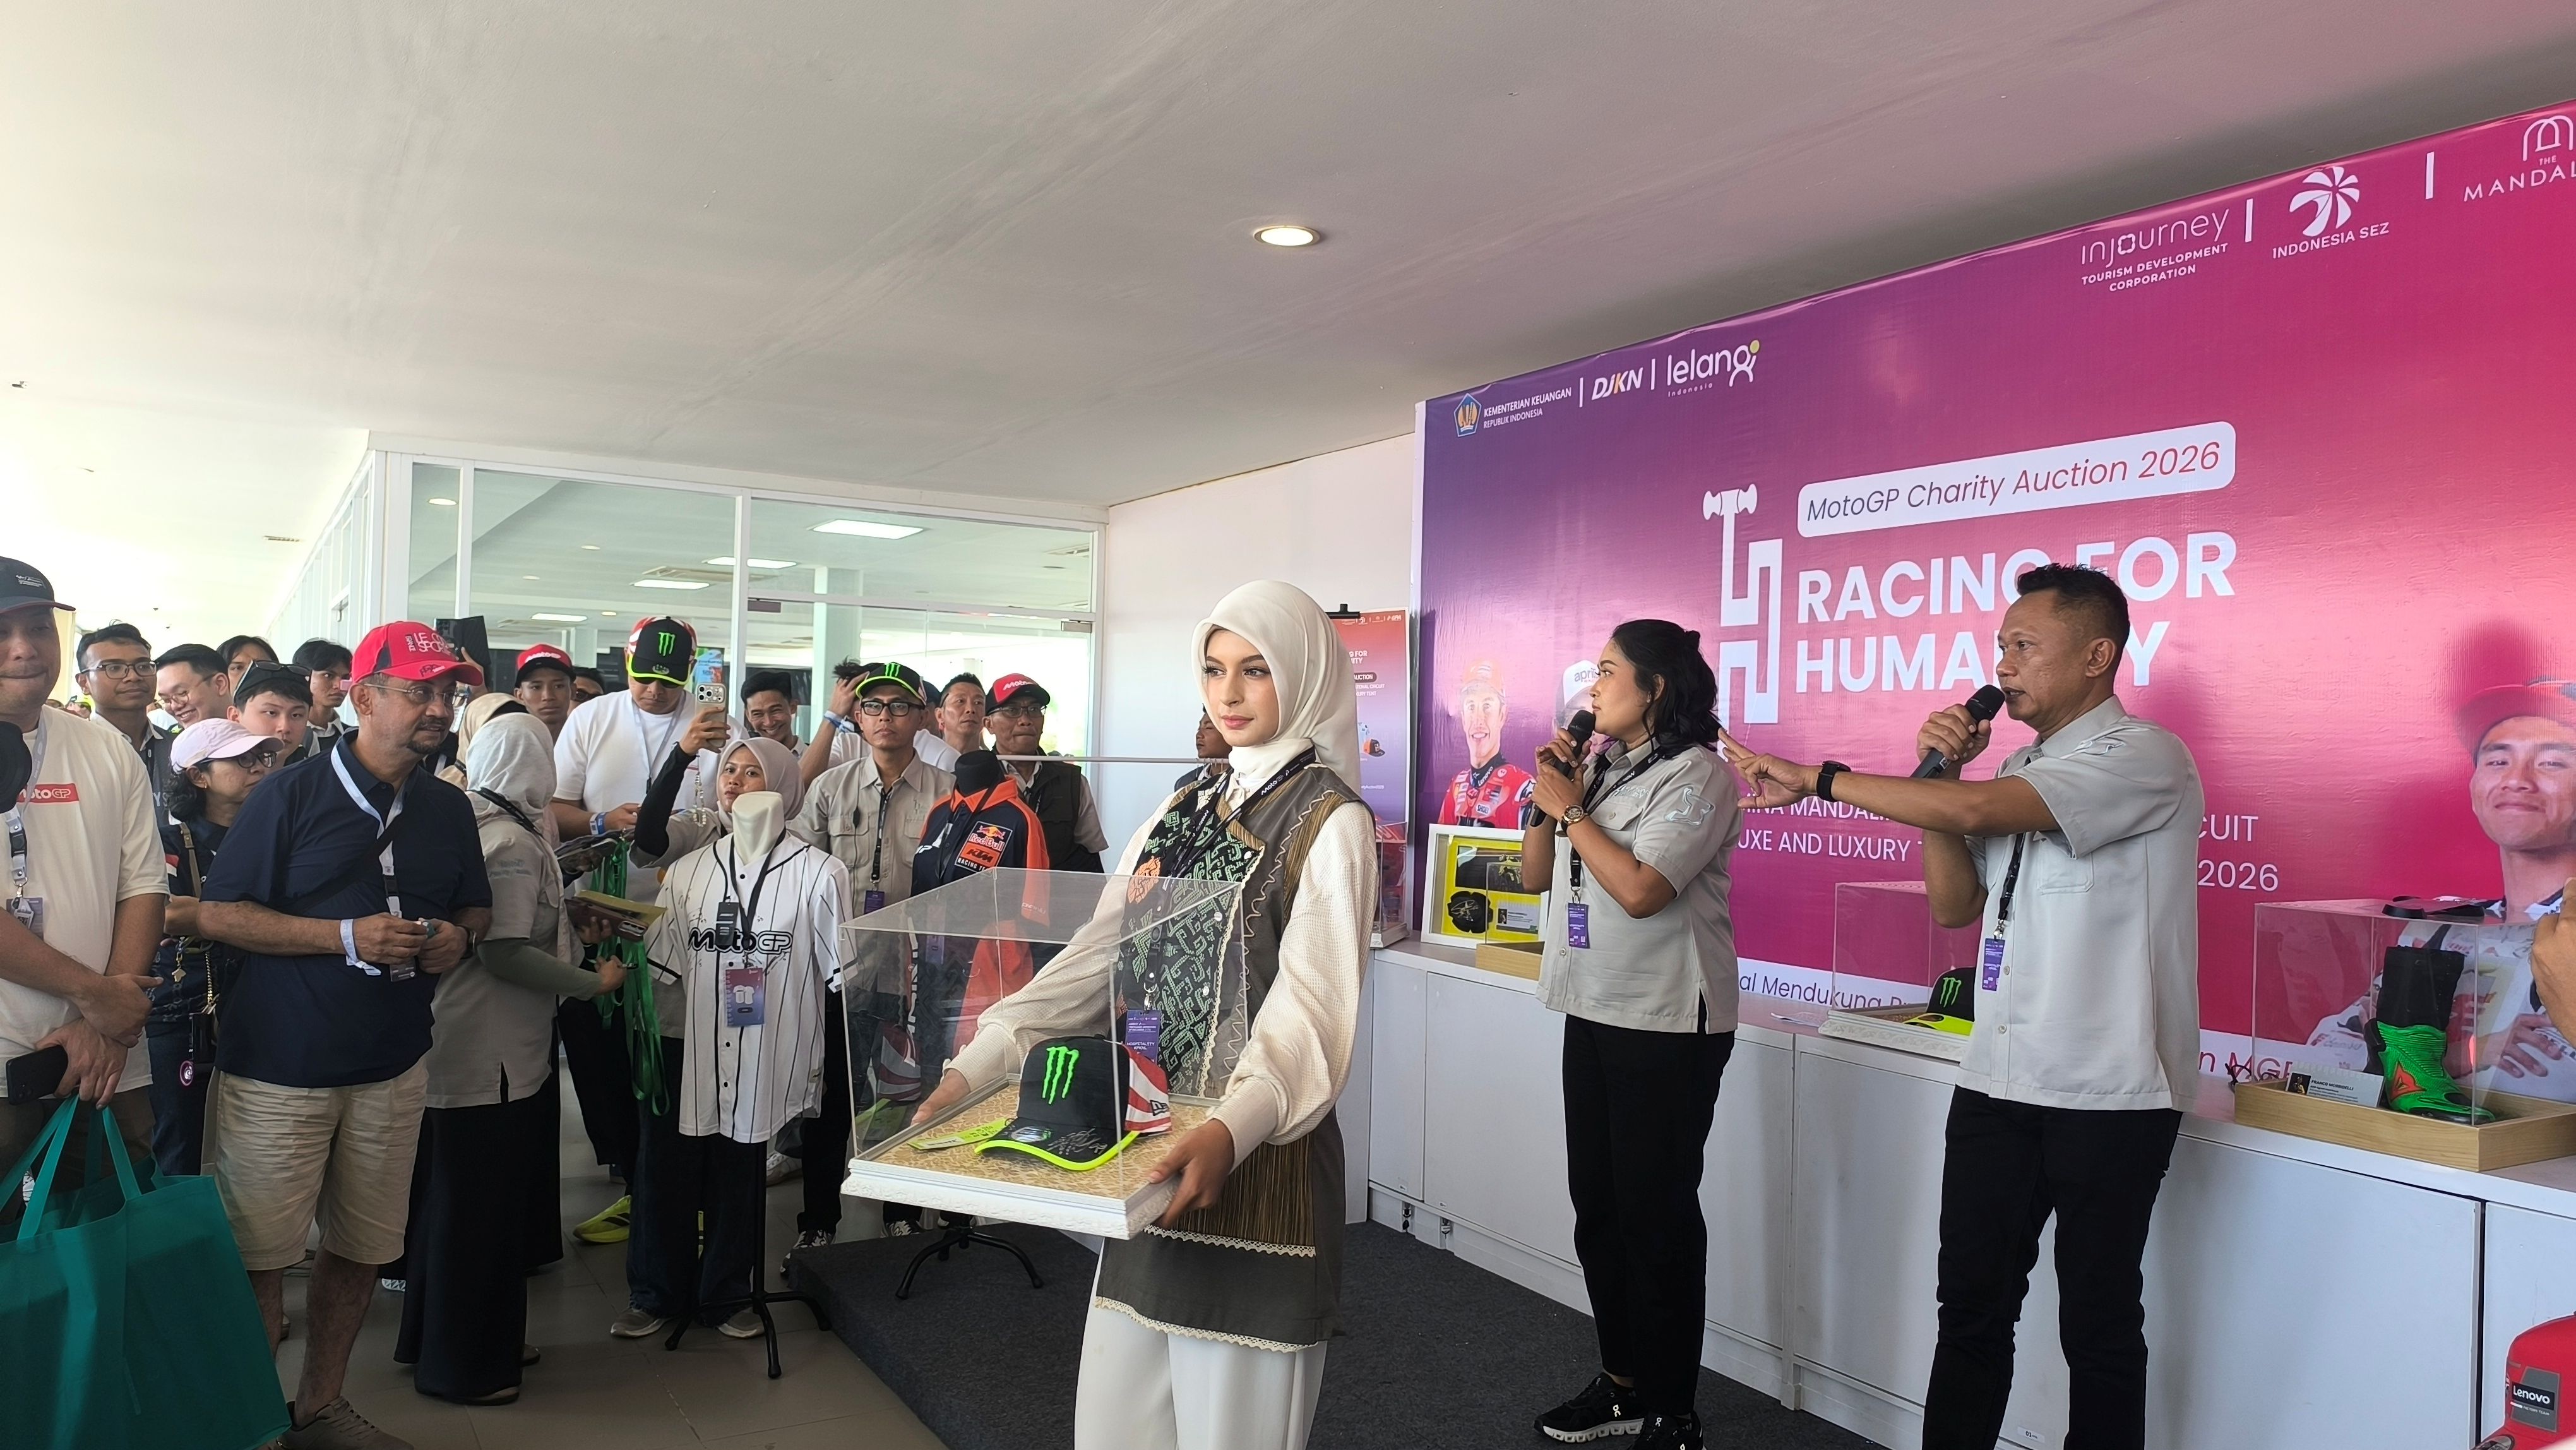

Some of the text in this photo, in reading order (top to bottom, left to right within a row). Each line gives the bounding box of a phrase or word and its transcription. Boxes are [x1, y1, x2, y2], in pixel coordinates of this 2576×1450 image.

[2539, 155, 2556, 165] THE
[2272, 221, 2390, 259] INDONESIA SEZ
[2081, 243, 2228, 285] TOURISM DEVELOPMENT
[2109, 264, 2196, 291] CORPORATION
[1591, 367, 1643, 400] DJKN
[1484, 386, 1571, 417] KEMENTERIAN KEUANGAN
[1483, 407, 1543, 429] REPUBLIK INDONESIA
[1807, 442, 2220, 523] MotoGP Charity Auction 2026
[1796, 621, 2171, 695] HUMAY
[2198, 813, 2258, 842] UIT
[967, 848, 994, 863] KTM
[1738, 829, 1911, 862] UXE AND LUXURY
[2198, 860, 2279, 892] 2026
[688, 928, 793, 955] MtoGP
[2513, 1385, 2550, 1404] Lenovo
